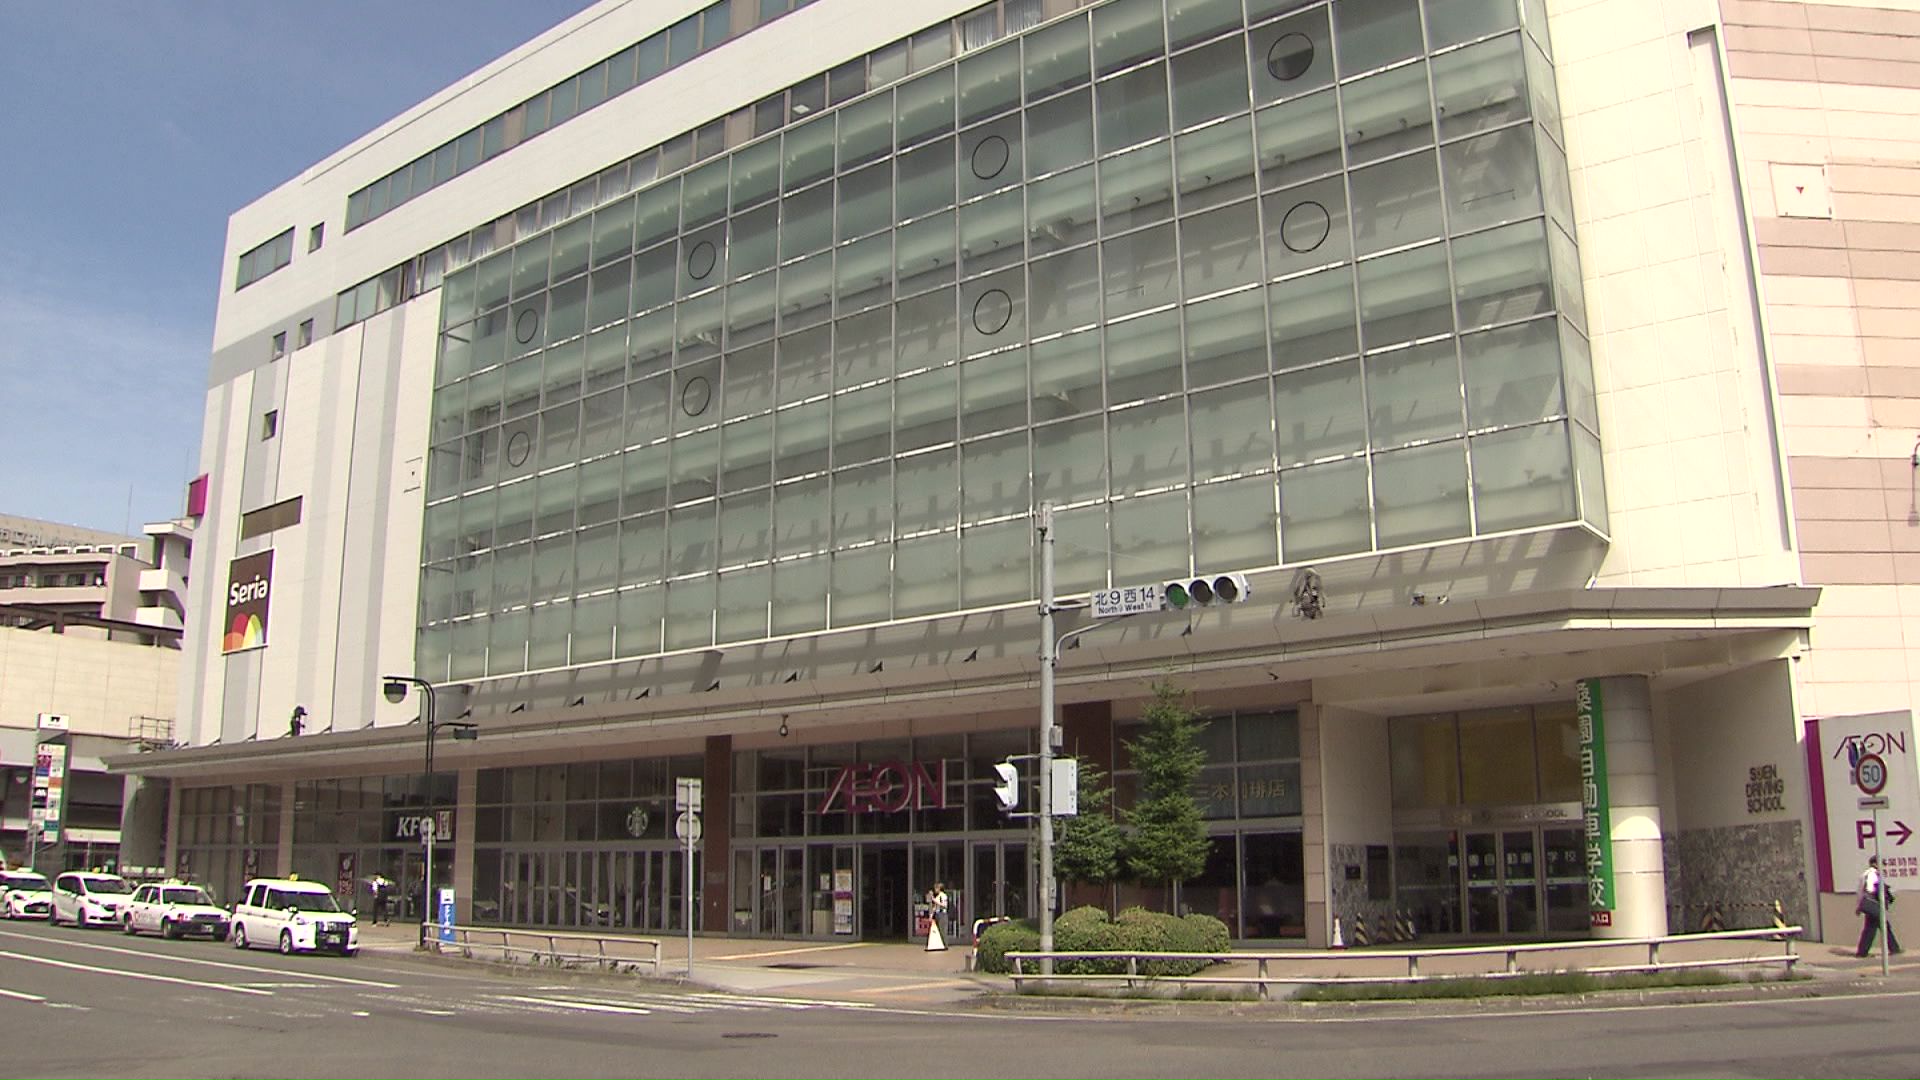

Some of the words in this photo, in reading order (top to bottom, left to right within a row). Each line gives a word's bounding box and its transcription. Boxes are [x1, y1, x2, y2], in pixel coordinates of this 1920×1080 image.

[230, 574, 268, 606] Seria
[1098, 606, 1118, 615] North
[1125, 602, 1145, 611] West
[1862, 765, 1881, 783] 50
[1748, 797, 1786, 813] SCHOOL
[396, 816, 436, 837] KF
[1856, 820, 1877, 849] P
